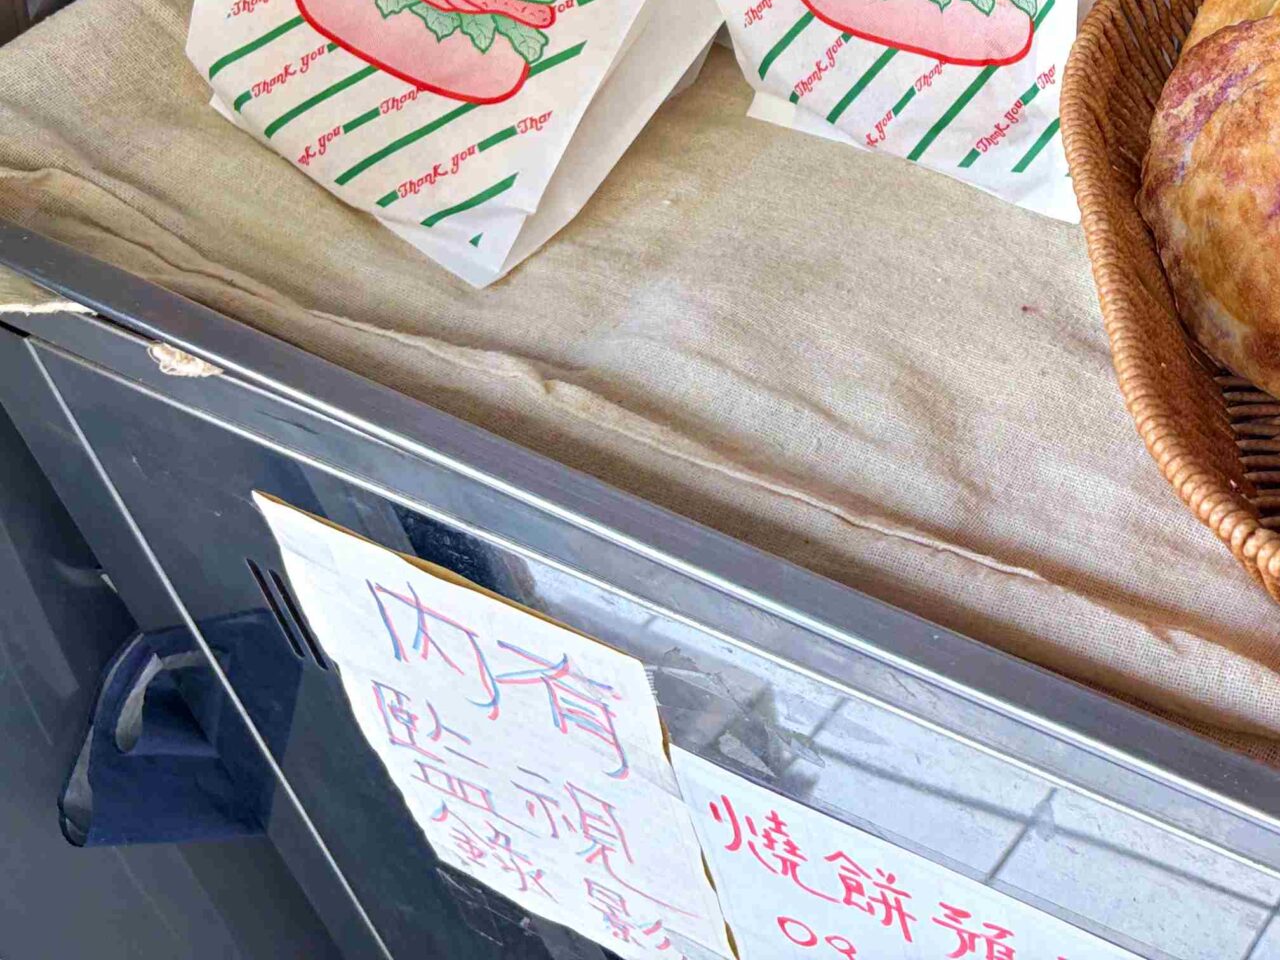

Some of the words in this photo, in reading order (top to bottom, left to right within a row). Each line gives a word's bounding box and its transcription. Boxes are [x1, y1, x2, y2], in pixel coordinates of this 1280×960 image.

[251, 63, 297, 97] Thank
[299, 44, 326, 73] you
[794, 60, 829, 97] Thank
[825, 35, 844, 68] you
[318, 125, 341, 155] you
[875, 110, 893, 141] you
[976, 122, 1010, 154] Thank
[1004, 99, 1023, 126] you
[1037, 64, 1056, 89] Tha
[398, 163, 449, 198] Thank
[450, 144, 477, 174] you
[517, 110, 554, 134] Tha
[370, 679, 705, 919] 監視
[708, 793, 1016, 960] 燒餅預
